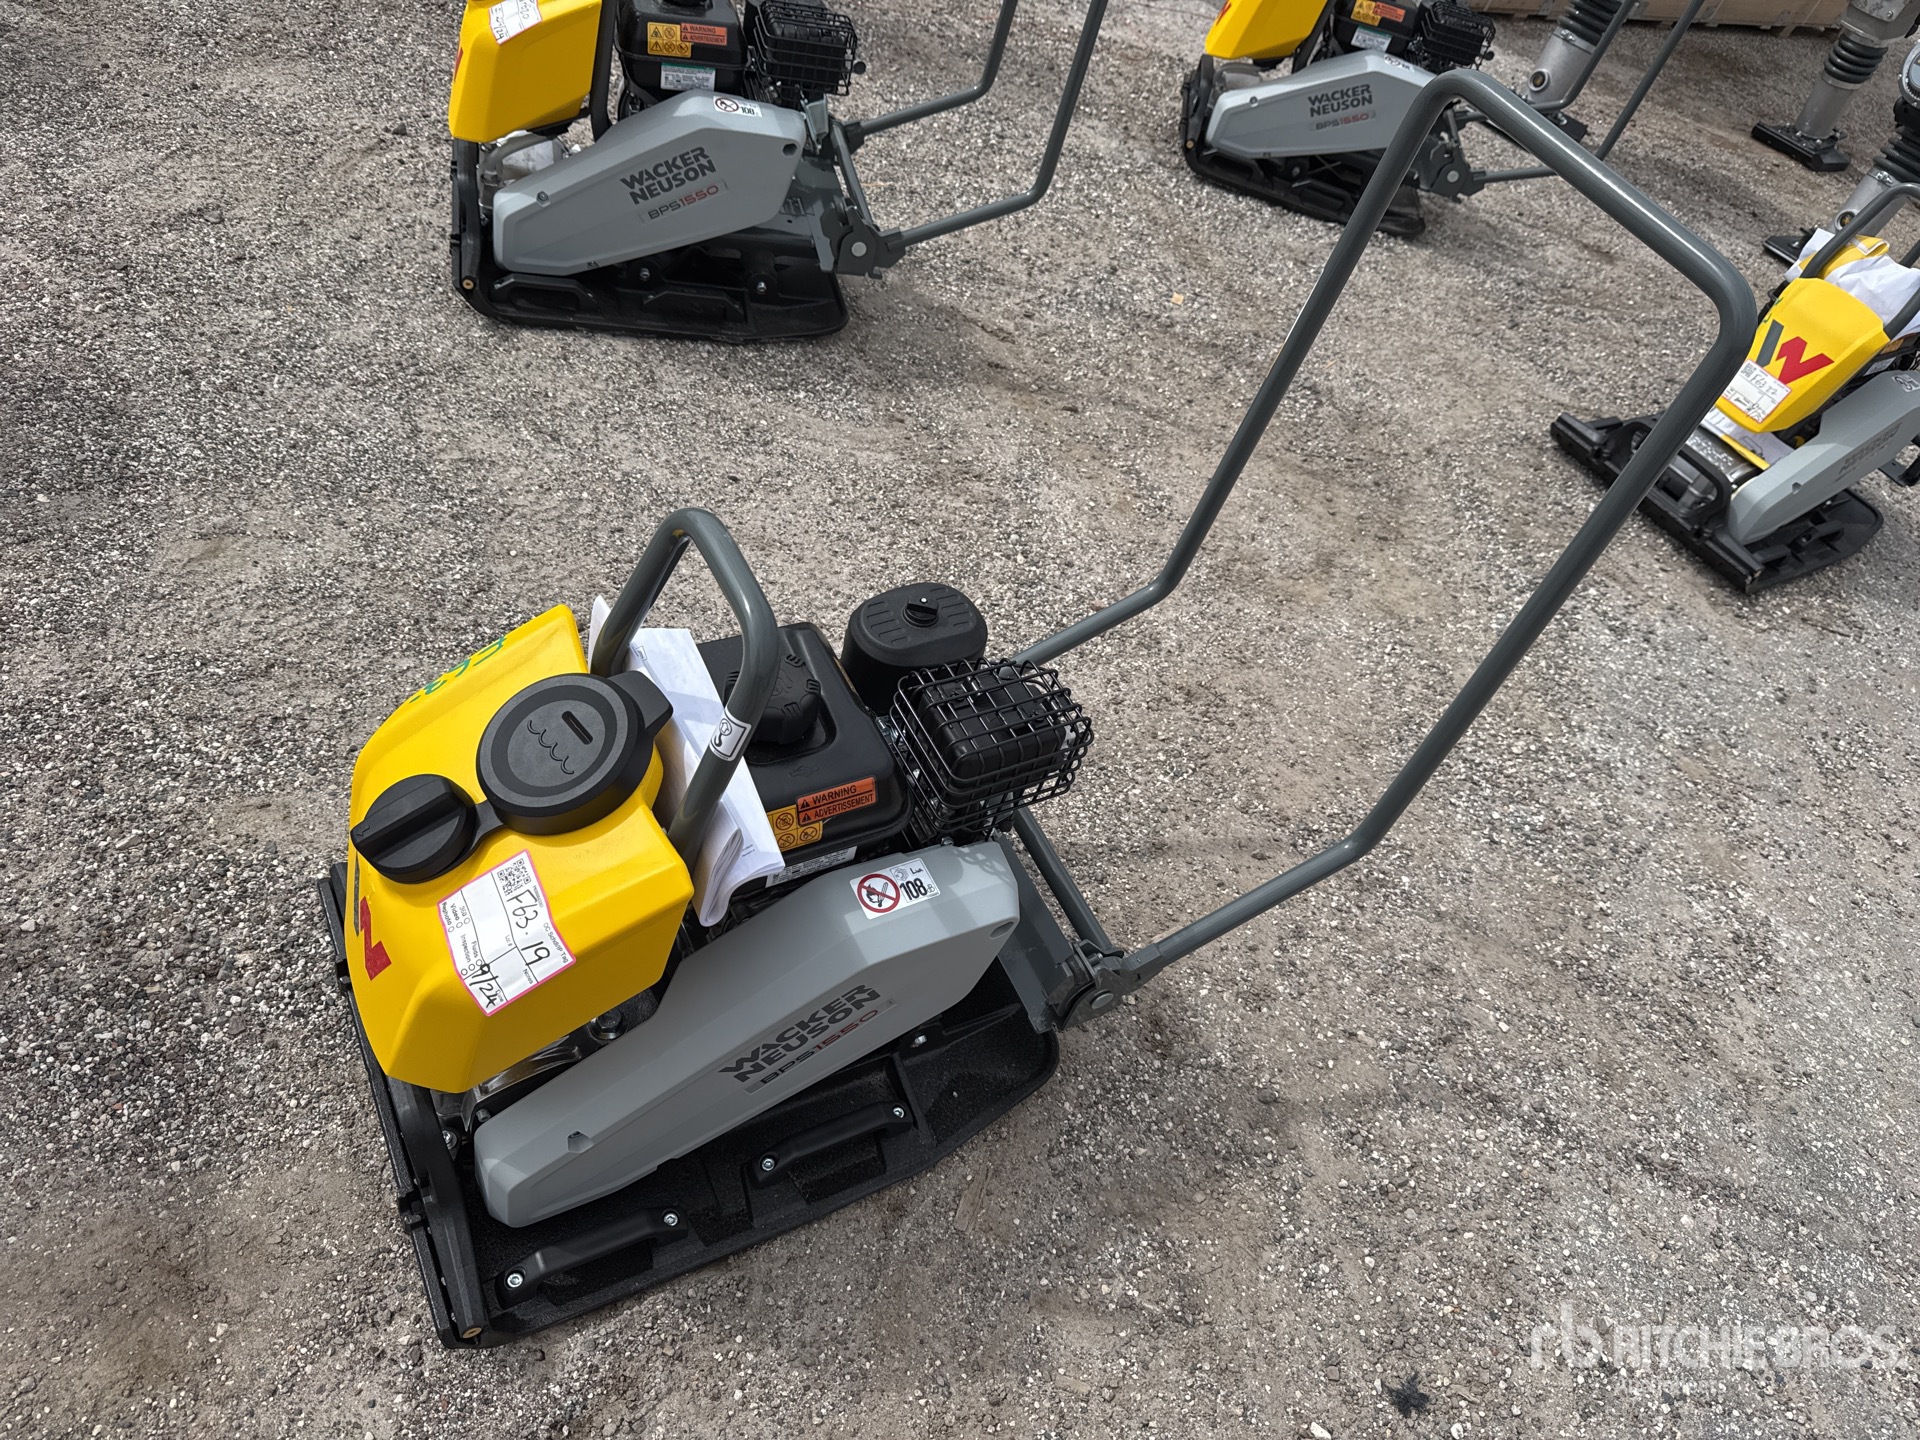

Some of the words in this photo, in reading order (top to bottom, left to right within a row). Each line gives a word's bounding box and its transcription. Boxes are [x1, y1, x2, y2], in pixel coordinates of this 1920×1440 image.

[690, 25, 716, 34] WARNING
[1307, 84, 1372, 106] WACKER
[1310, 95, 1373, 117] NEUSON
[620, 146, 710, 190] WACKER
[629, 159, 716, 205] NEUSON
[648, 185, 719, 219] BPS1550
[812, 785, 857, 805] WARNING
[814, 794, 873, 818] ADVERTISSEMENT
[900, 878, 928, 900] 108
[450, 903, 460, 921] Video
[460, 933, 471, 963] Inspection
[471, 940, 479, 958] Fluids
[521, 941, 550, 966] 19
[718, 984, 874, 1073] WACKER
[732, 990, 881, 1083] NEUSON
[760, 1009, 879, 1084] BPS1550
